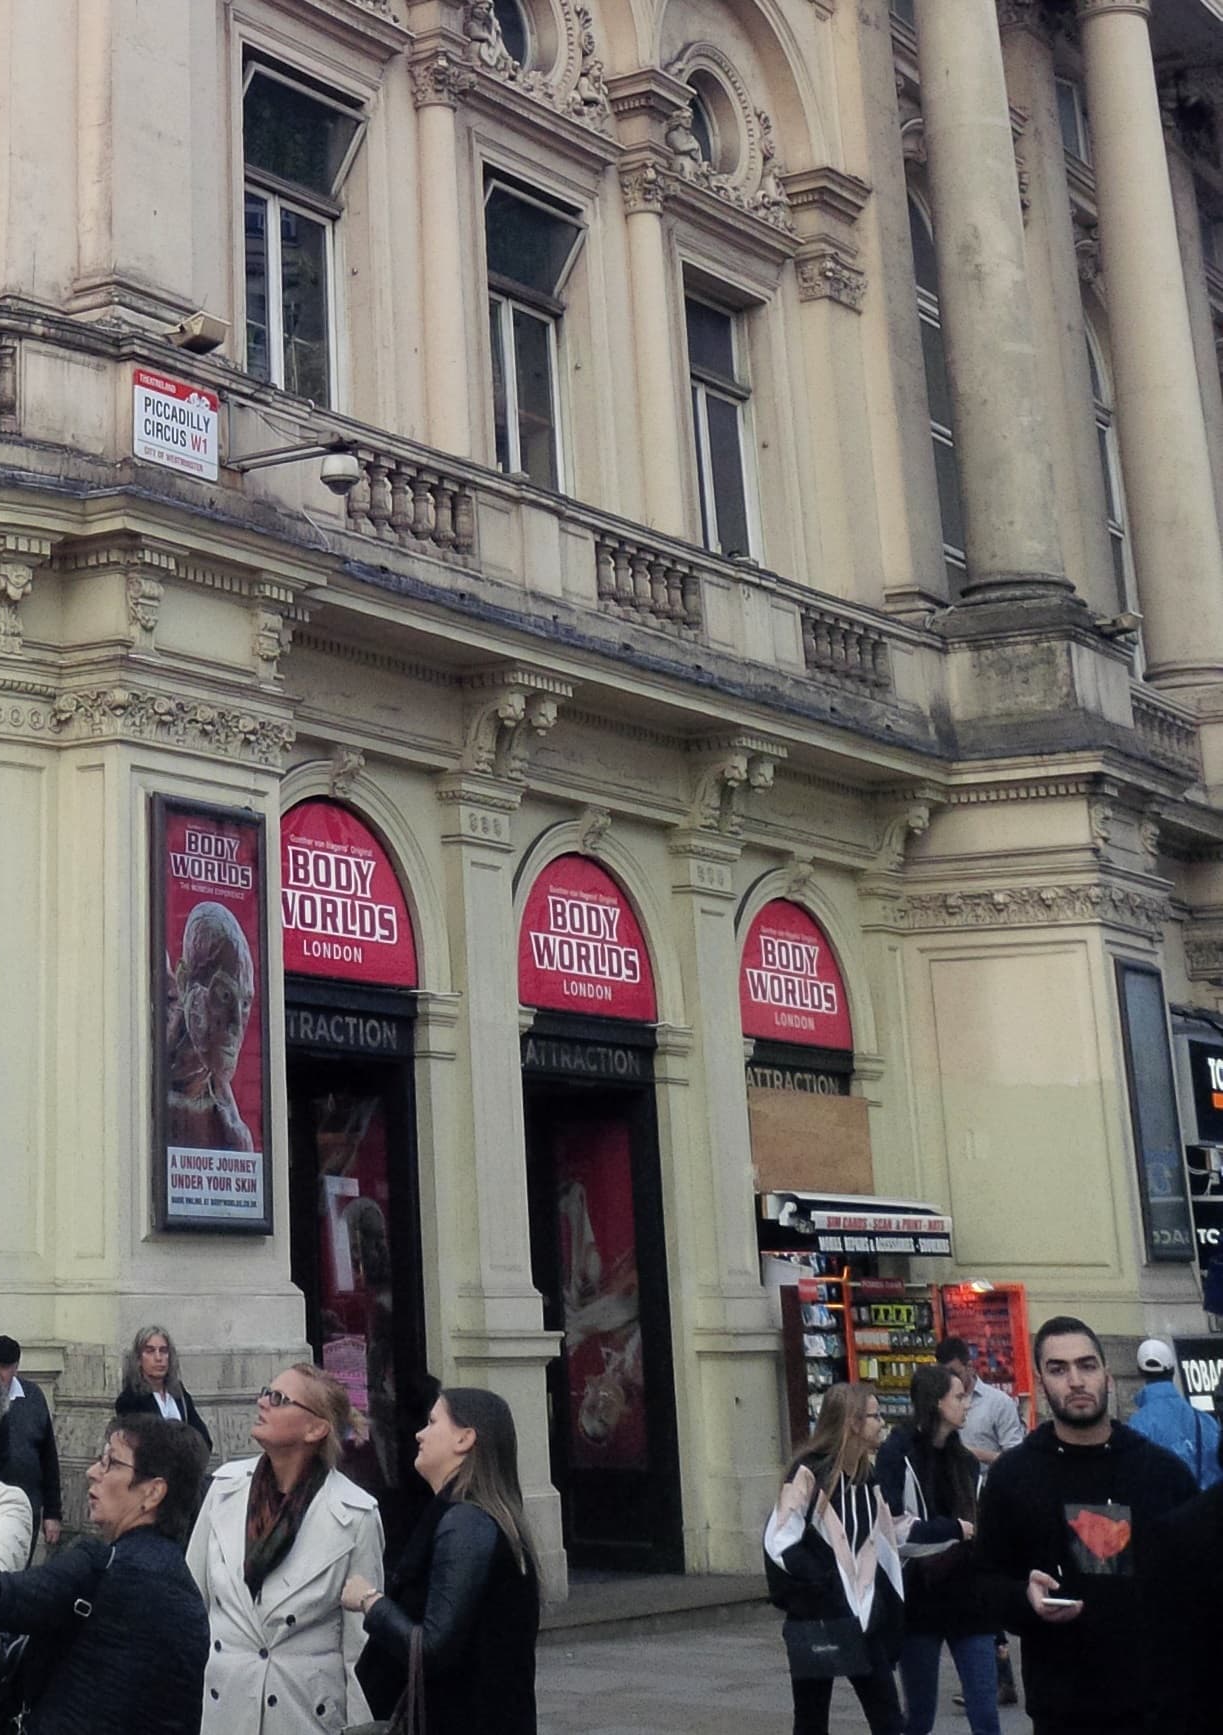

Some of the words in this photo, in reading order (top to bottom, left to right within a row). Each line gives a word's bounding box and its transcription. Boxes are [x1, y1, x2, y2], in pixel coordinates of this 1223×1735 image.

[144, 396, 210, 433] PICCADILLY
[144, 419, 187, 447] CIRCUS
[191, 433, 208, 454] W1
[185, 830, 240, 862] BODY
[169, 851, 253, 890] WORLDS
[288, 845, 376, 898] BODY
[548, 895, 620, 942] BODY
[303, 940, 362, 964] LONDON
[529, 931, 640, 984] WORLDS
[760, 935, 819, 977] BODY
[563, 979, 612, 1001] LONDON
[746, 968, 838, 1014] WORLDS
[286, 1008, 397, 1050] TRACTION
[774, 1012, 815, 1031] LONDON
[525, 1039, 640, 1076] ATTRACTION
[746, 1066, 839, 1096] ATTRACTION
[171, 1154, 177, 1168] A
[180, 1155, 213, 1171] UNIQUE
[216, 1158, 256, 1174] JOURNEY
[171, 1174, 203, 1190] UNDER
[207, 1176, 232, 1192] YOUR
[235, 1179, 256, 1193] SKIN
